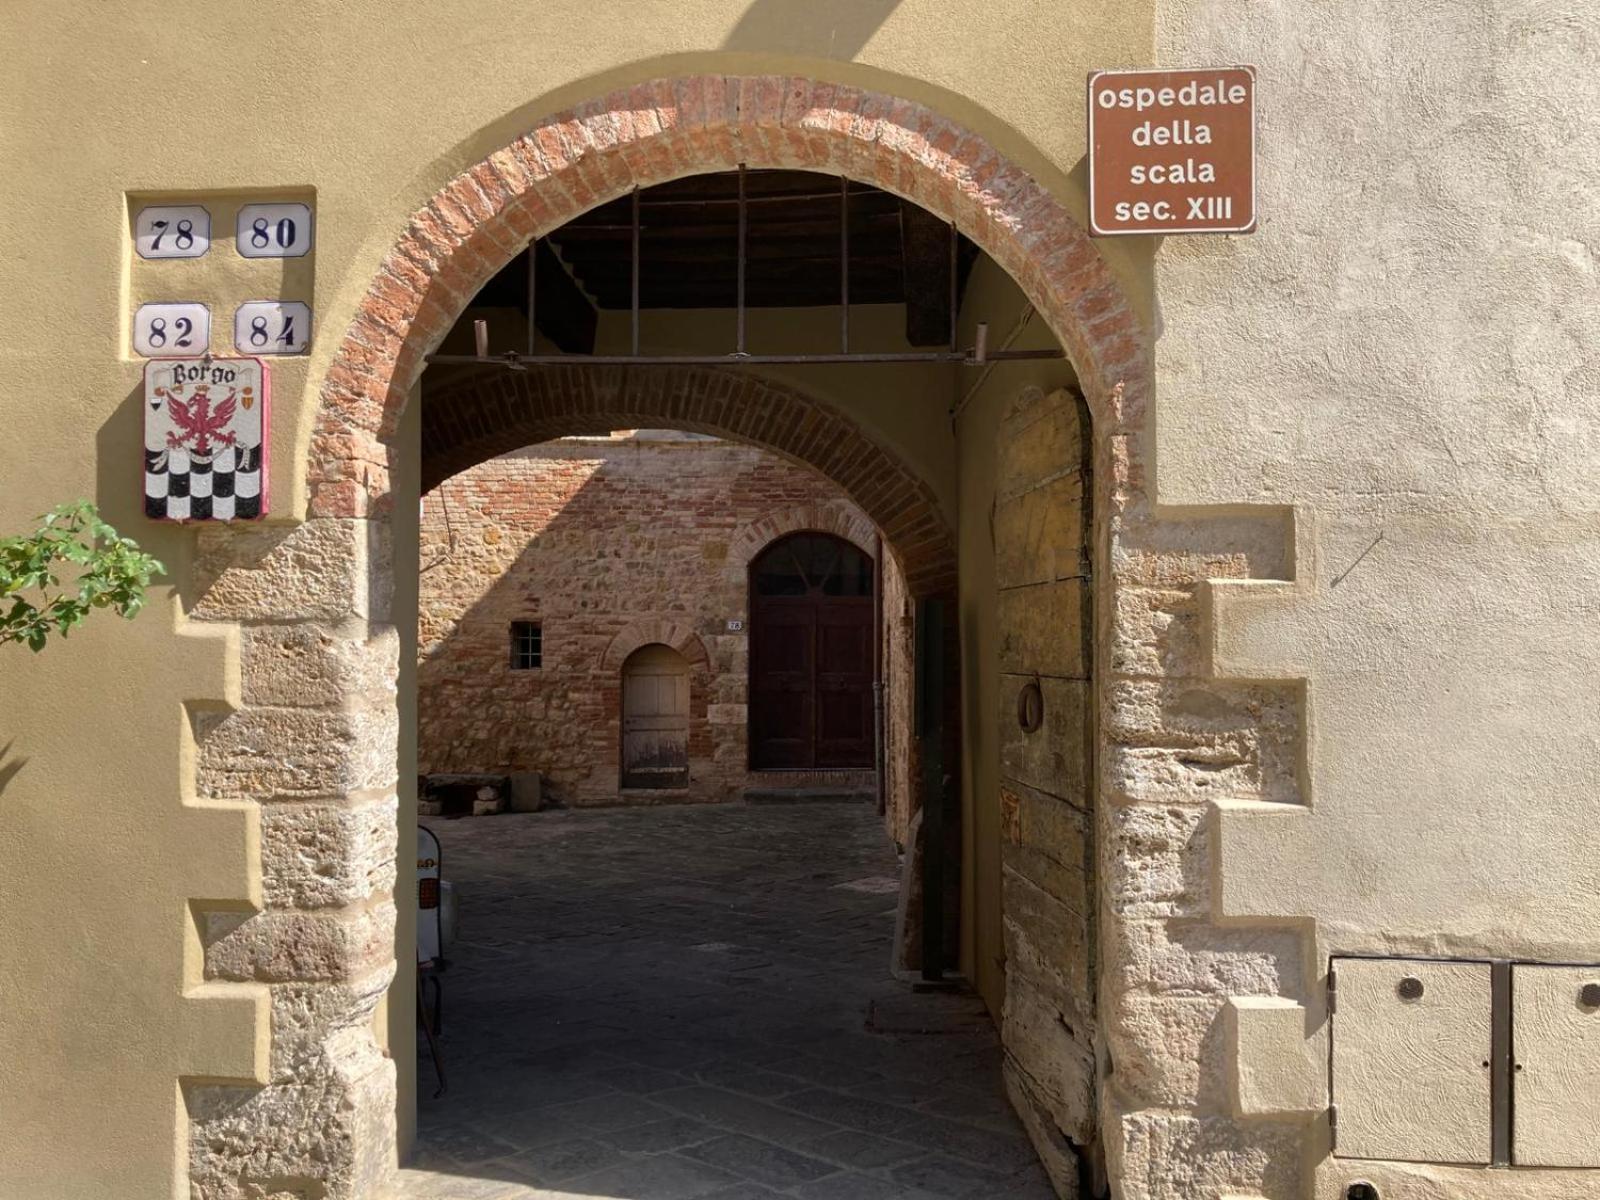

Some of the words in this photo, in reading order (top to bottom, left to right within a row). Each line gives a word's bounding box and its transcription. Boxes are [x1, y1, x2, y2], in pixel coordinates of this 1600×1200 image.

[1099, 80, 1247, 111] ospedale
[1132, 120, 1212, 146] della
[1130, 158, 1215, 184] scala
[1115, 200, 1176, 221] sec.
[1186, 197, 1231, 220] XIII
[151, 219, 194, 250] 78
[251, 217, 296, 249] 80
[149, 317, 192, 348] 82
[250, 315, 295, 347] 84
[172, 363, 236, 385] Borgo
